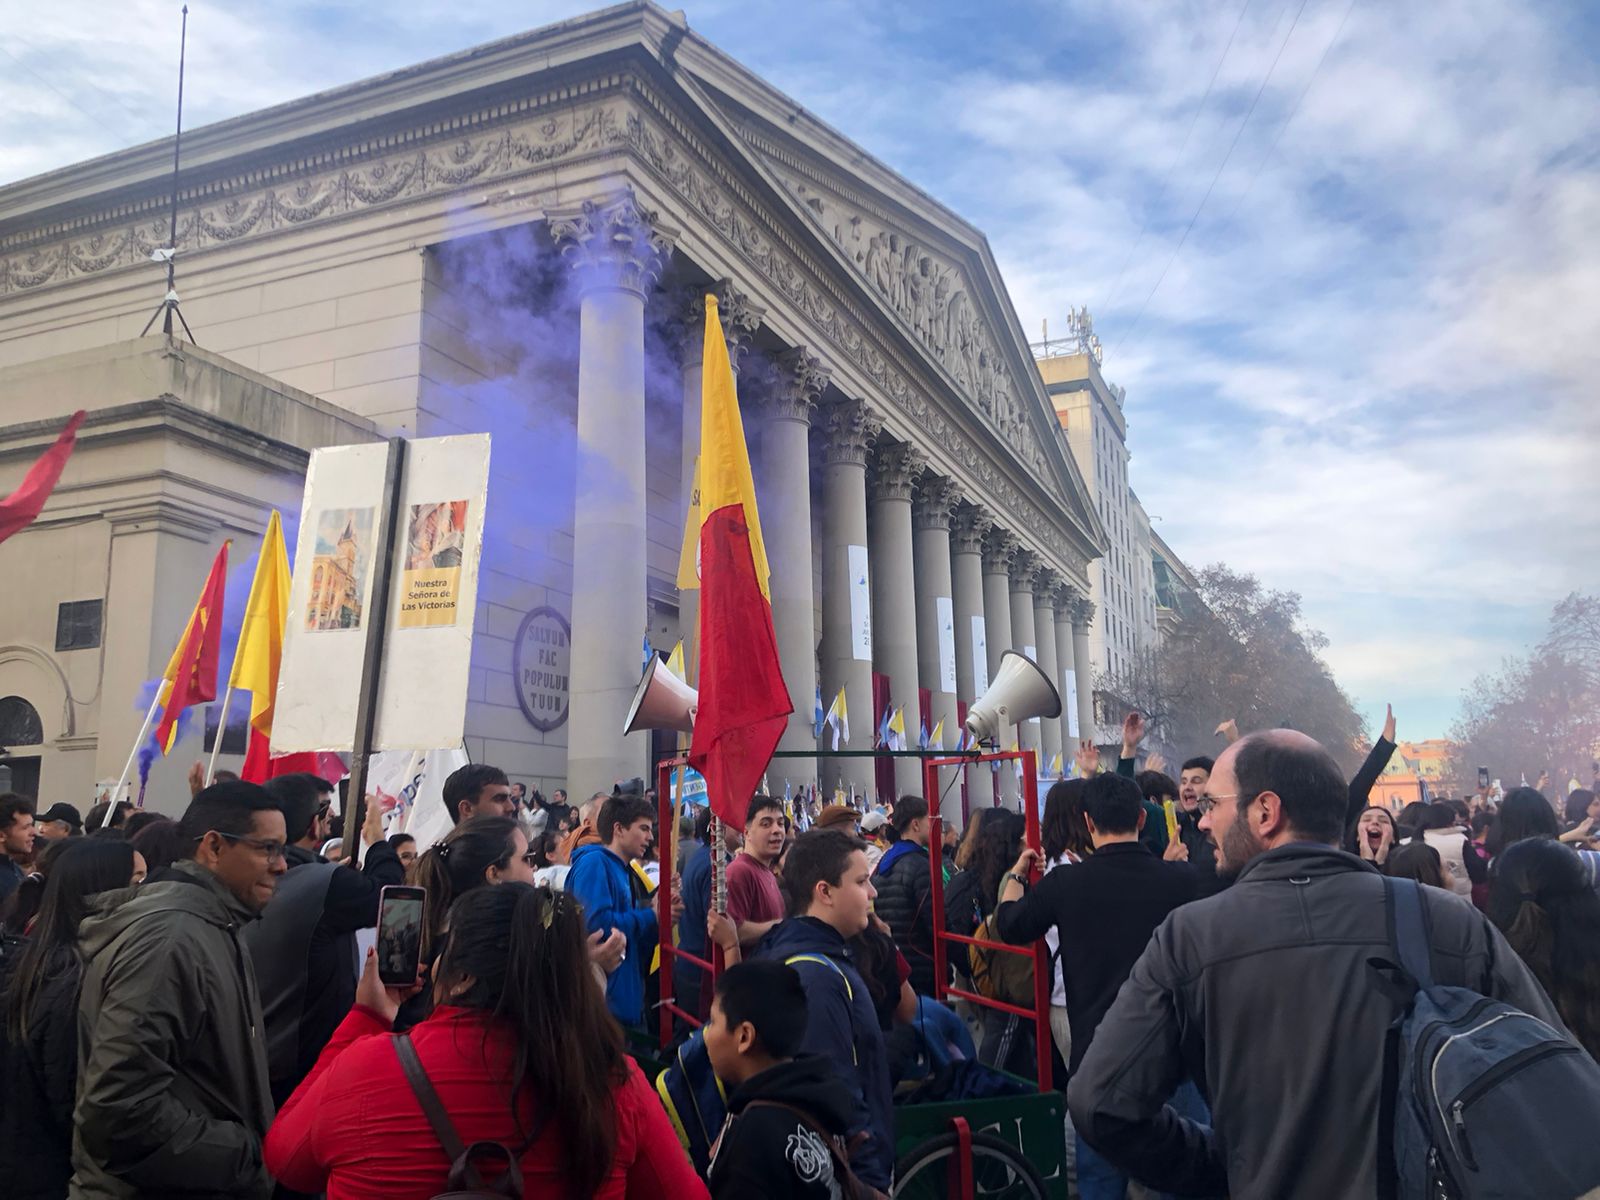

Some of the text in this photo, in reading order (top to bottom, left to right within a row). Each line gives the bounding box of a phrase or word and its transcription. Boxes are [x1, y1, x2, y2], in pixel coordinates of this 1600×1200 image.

[414, 579, 448, 588] Nuestra
[408, 590, 451, 600] Señora de
[401, 601, 456, 611] Las Victorias
[528, 624, 565, 648] SALVUM
[538, 648, 557, 667] FAC
[523, 668, 569, 692] POPULUM
[530, 692, 561, 713] TUUM
